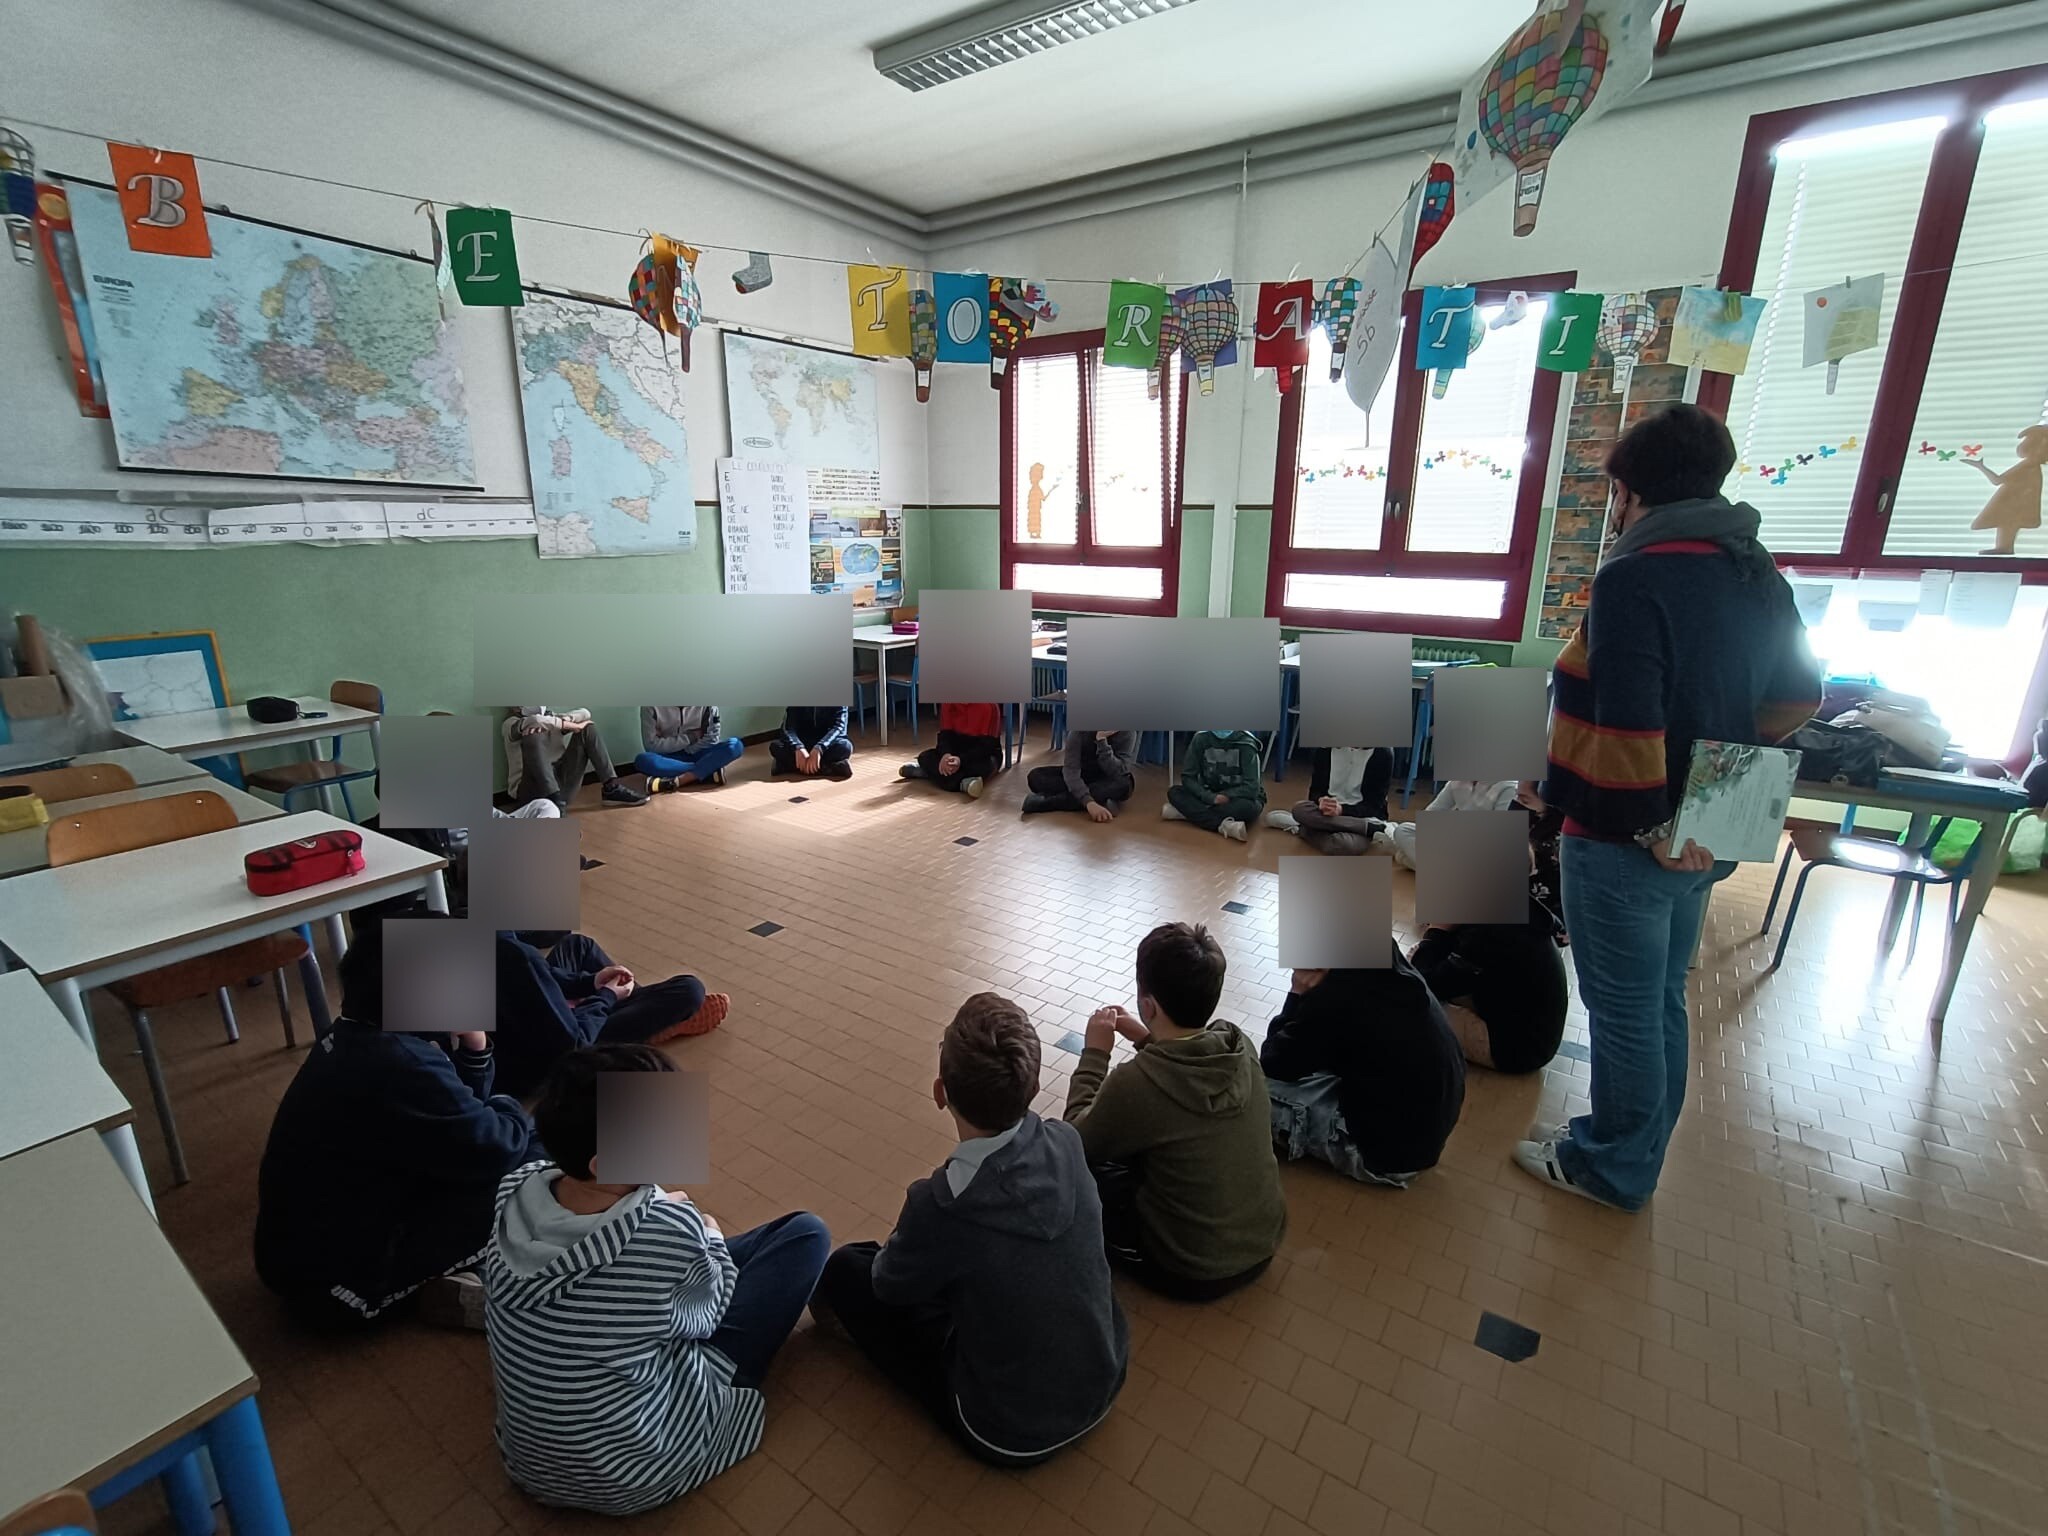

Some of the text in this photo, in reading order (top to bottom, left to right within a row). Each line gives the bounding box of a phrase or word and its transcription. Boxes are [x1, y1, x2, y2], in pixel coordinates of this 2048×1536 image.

[126, 173, 1580, 355] B E T O R A T I
[724, 471, 730, 482] E
[303, 526, 313, 538] 0
